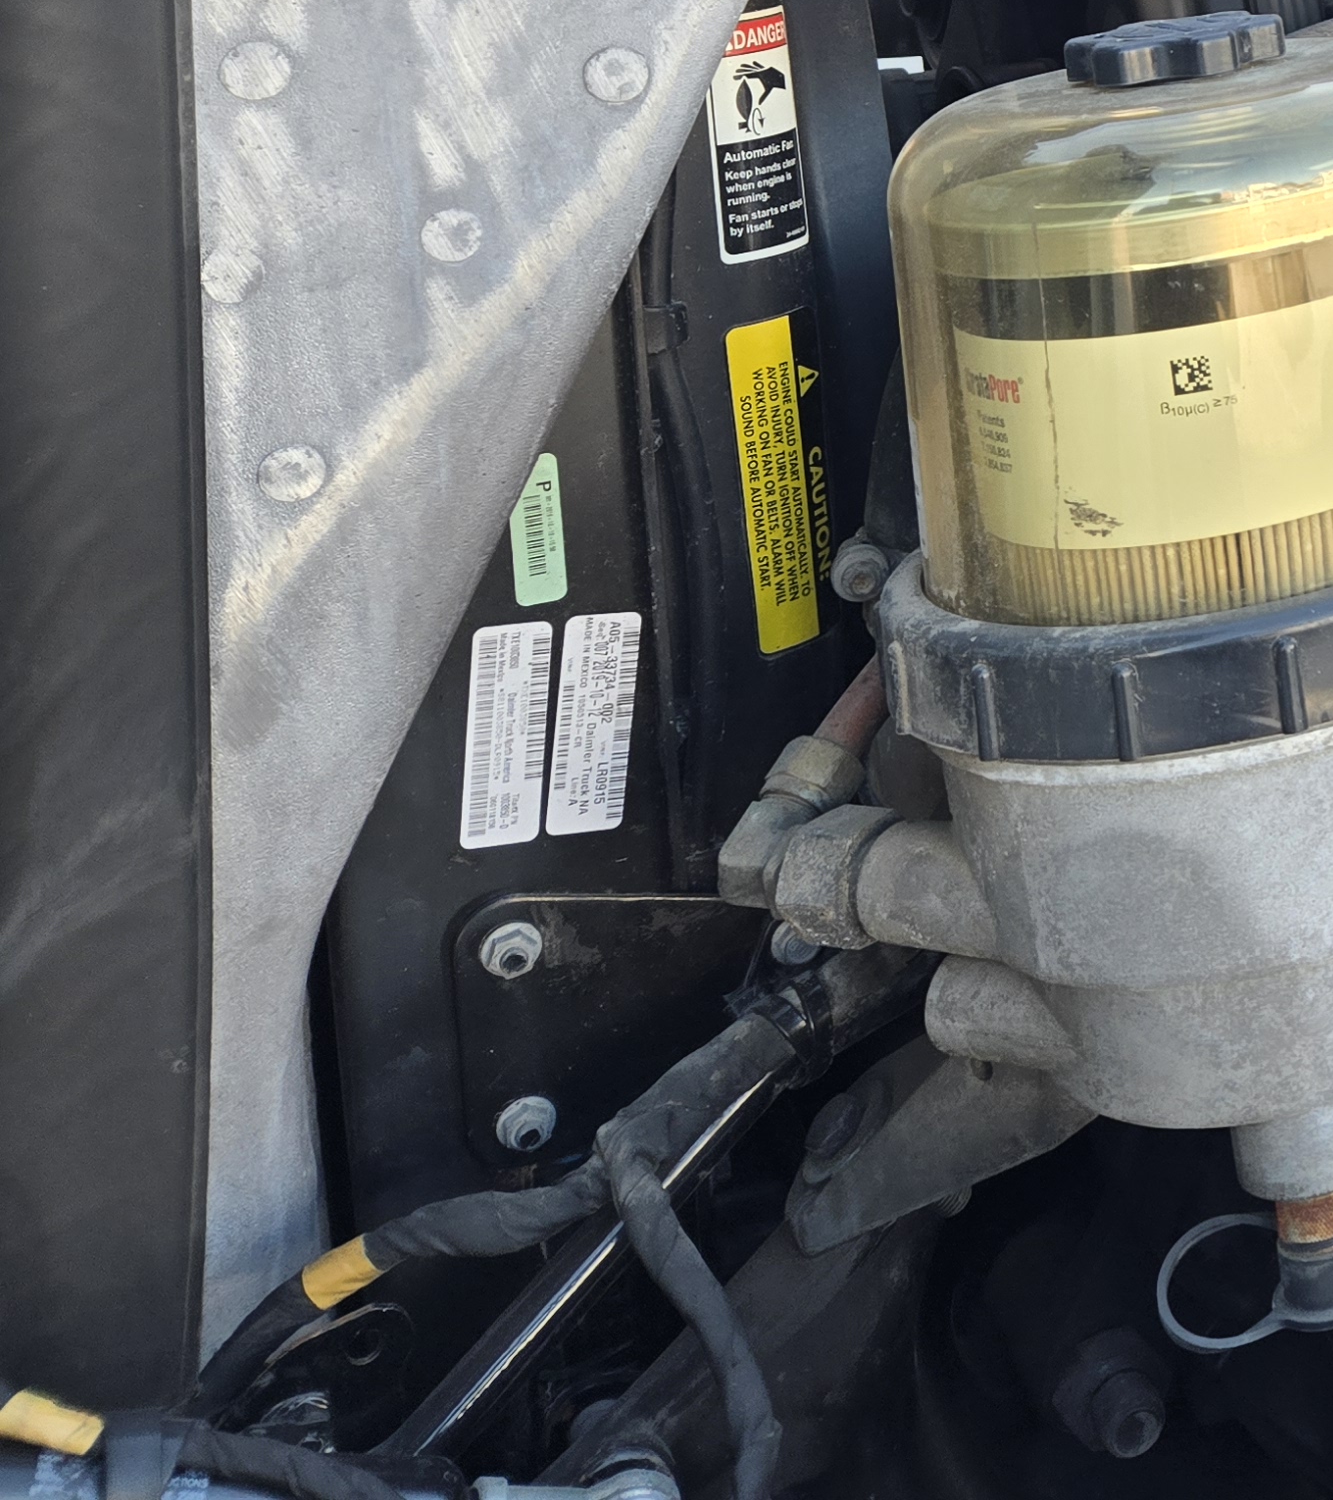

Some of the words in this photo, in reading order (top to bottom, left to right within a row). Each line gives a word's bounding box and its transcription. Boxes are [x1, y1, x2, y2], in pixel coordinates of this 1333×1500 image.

[723, 143, 781, 164] Automatic
[725, 169, 753, 182] Keep
[754, 162, 782, 176] hands
[725, 182, 756, 194] when
[756, 174, 785, 188] engine
[785, 171, 793, 181] is
[727, 192, 771, 207] running.
[728, 213, 750, 224] Fan
[750, 206, 779, 220] starts
[729, 226, 744, 238] by
[745, 219, 775, 235] itself.
[752, 368, 768, 427] WORKING
[766, 367, 779, 401] AVOID
[779, 362, 792, 405] ENGINE
[740, 395, 754, 437] SOUND
[770, 405, 784, 448] INJURY,
[783, 409, 797, 446] COULD
[759, 431, 771, 450] ON
[745, 441, 760, 483] BEFORE
[761, 454, 774, 477] FAN
[775, 450, 789, 481] TURN
[788, 450, 802, 481] START
[536, 481, 551, 492] P
[764, 480, 776, 497] OR
[750, 487, 767, 553] AUTOMATIC
[766, 501, 779, 534] BELTS.
[777, 485, 794, 538] IGNITION
[809, 446, 831, 581] CAUTION:
[791, 487, 810, 578] AUTOMATICALLY.
[770, 538, 785, 577] ALARM
[785, 541, 796, 562] OFF
[758, 557, 771, 591] START.
[786, 566, 799, 602] WHEN
[801, 580, 811, 596] TO
[775, 579, 787, 606] WILL
[584, 617, 594, 641] MADE
[580, 656, 590, 688] MEXICO
[583, 723, 597, 763] Daimler
[580, 767, 592, 796] Truck
[593, 762, 609, 805] LR0915
[578, 800, 589, 815] NA
